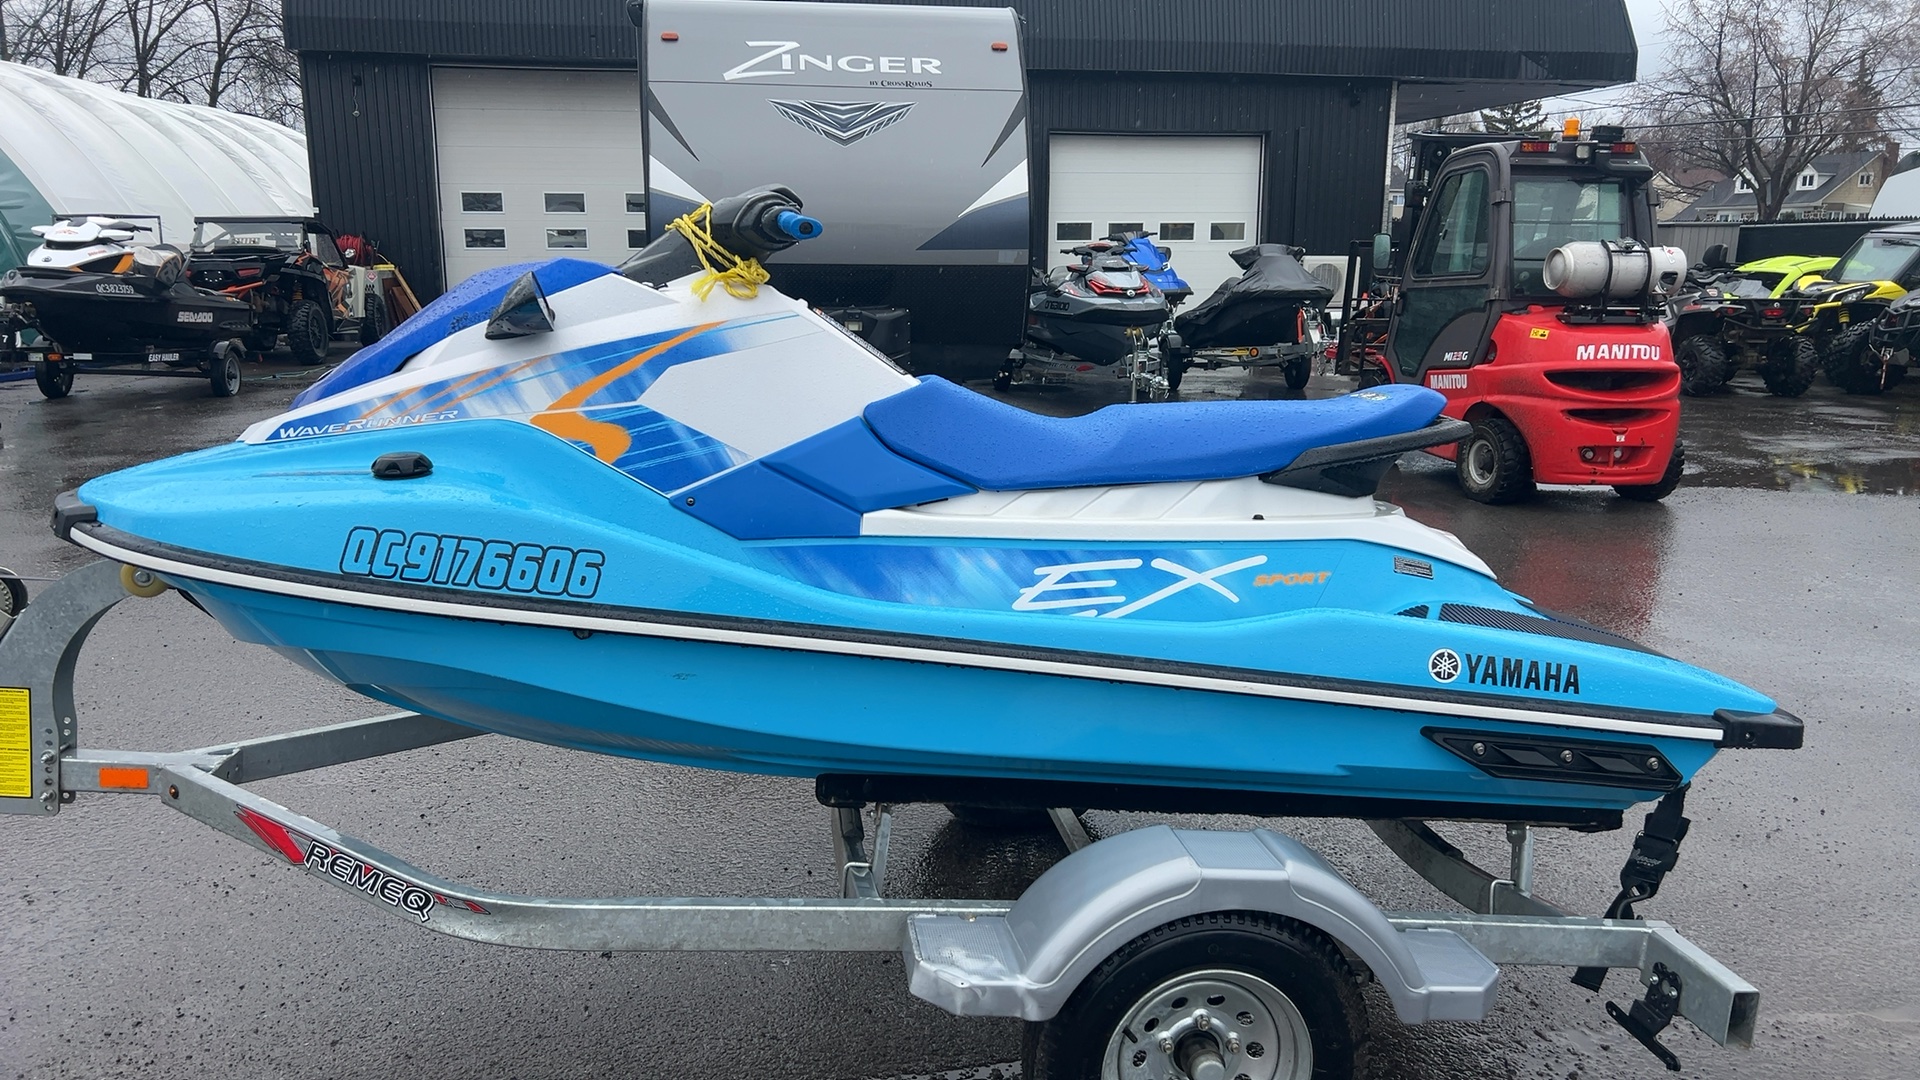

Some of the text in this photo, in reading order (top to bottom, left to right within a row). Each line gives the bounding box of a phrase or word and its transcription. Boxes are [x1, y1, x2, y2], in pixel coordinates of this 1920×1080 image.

[722, 40, 943, 81] ZINGER
[95, 283, 135, 295] QC3823759
[148, 353, 180, 362] EASY HAULER
[1576, 344, 1660, 361] MANITOU
[1430, 374, 1468, 389] MANITOU
[339, 526, 606, 599] QC9176606
[1011, 554, 1333, 619] EX SPORT
[1465, 653, 1580, 695] YAMAHA
[303, 839, 436, 923] REMEQ
